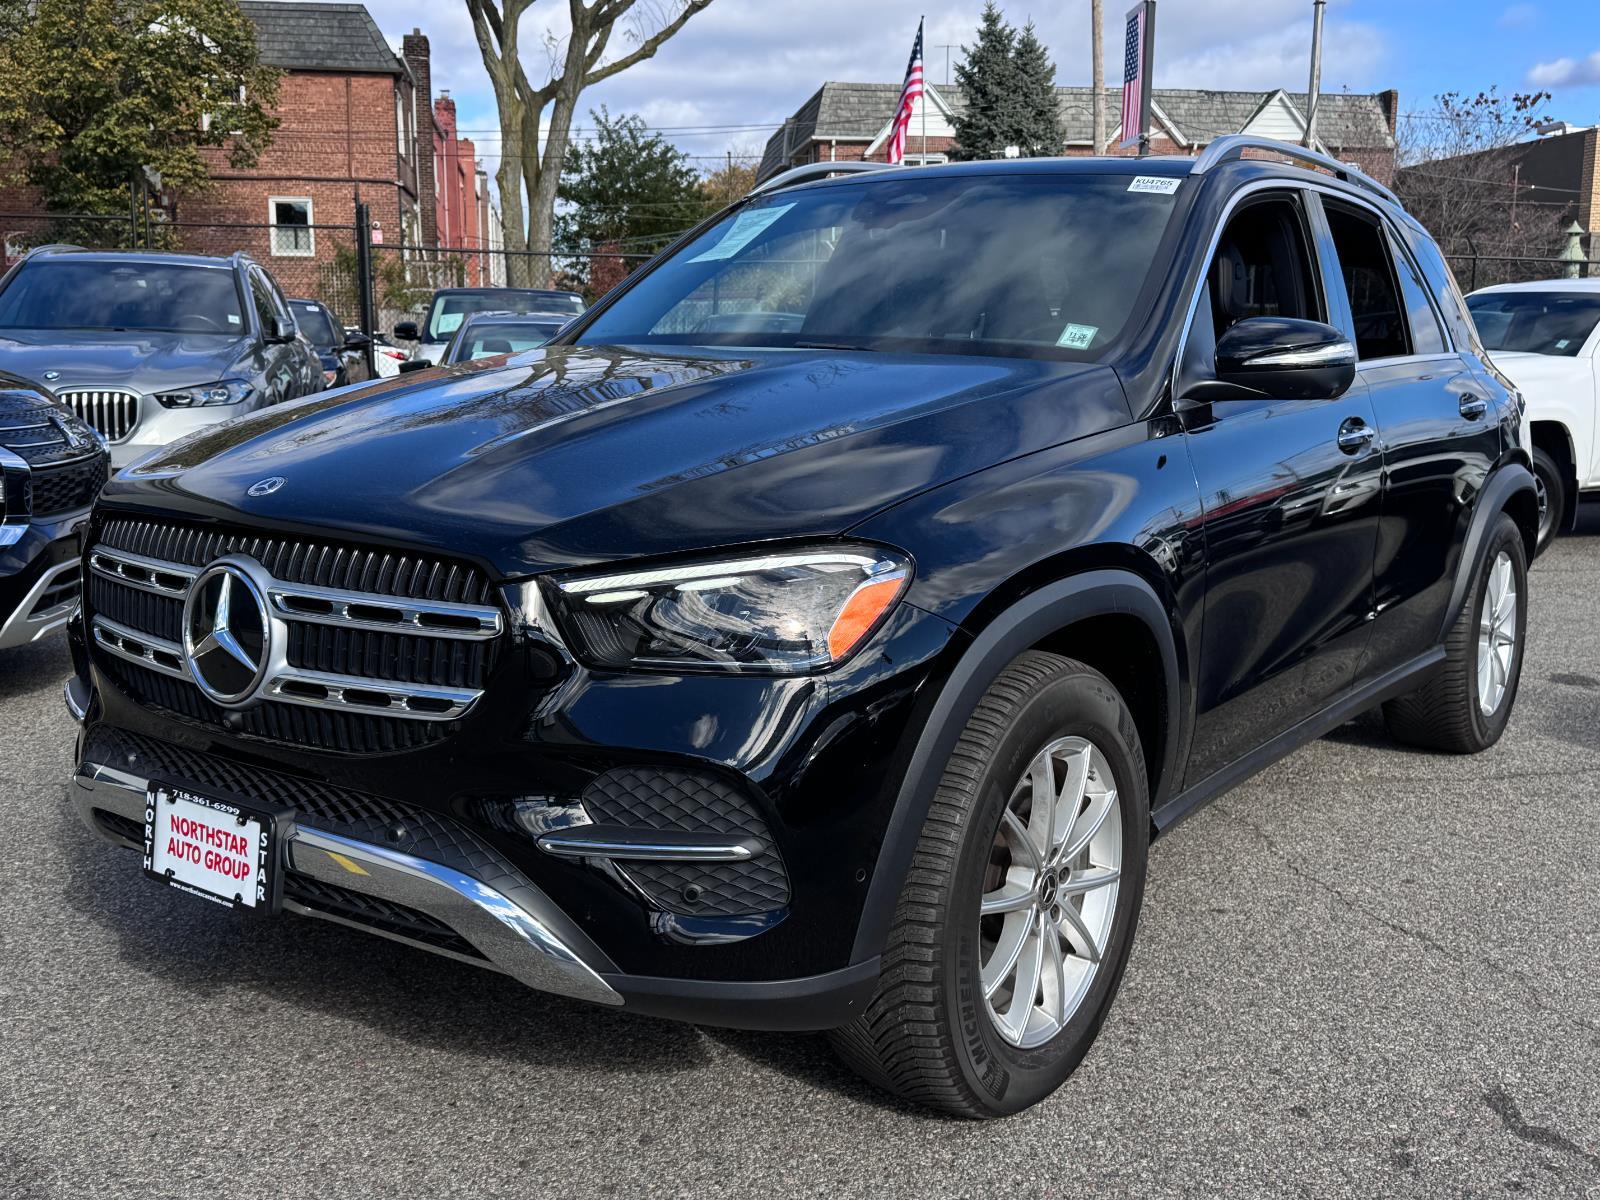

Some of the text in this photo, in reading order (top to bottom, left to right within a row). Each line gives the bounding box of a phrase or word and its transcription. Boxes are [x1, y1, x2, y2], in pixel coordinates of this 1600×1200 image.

[1135, 178, 1174, 187] KU4765
[172, 789, 240, 815] 718-361-6299
[143, 791, 155, 871] NORTH
[170, 814, 248, 857] NORTHSTAR
[167, 837, 250, 881] AUTO GROUP
[256, 832, 268, 901] STAR
